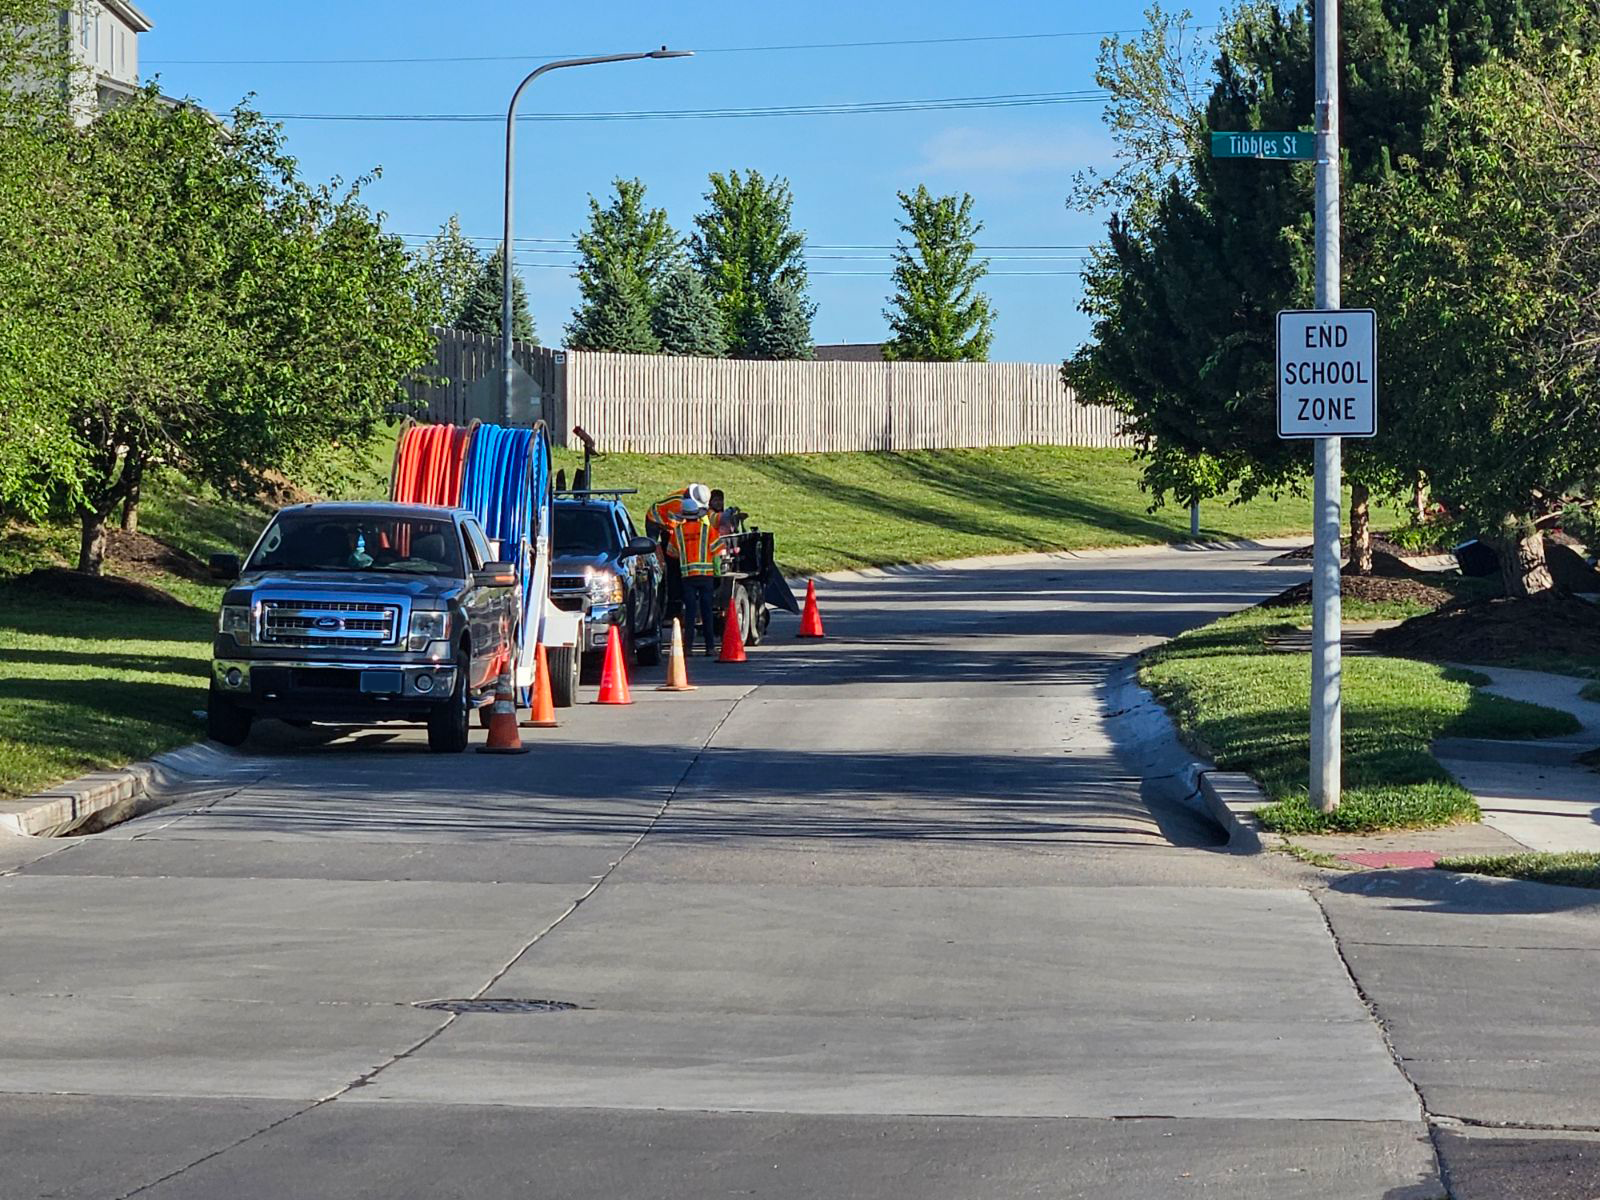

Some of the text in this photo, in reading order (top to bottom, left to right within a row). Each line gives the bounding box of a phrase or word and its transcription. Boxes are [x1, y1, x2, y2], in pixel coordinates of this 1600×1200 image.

[1229, 136, 1297, 155] Tibbles St
[1305, 325, 1348, 348] END
[1285, 361, 1368, 385] SCHOOL
[1297, 397, 1356, 421] ZONE
